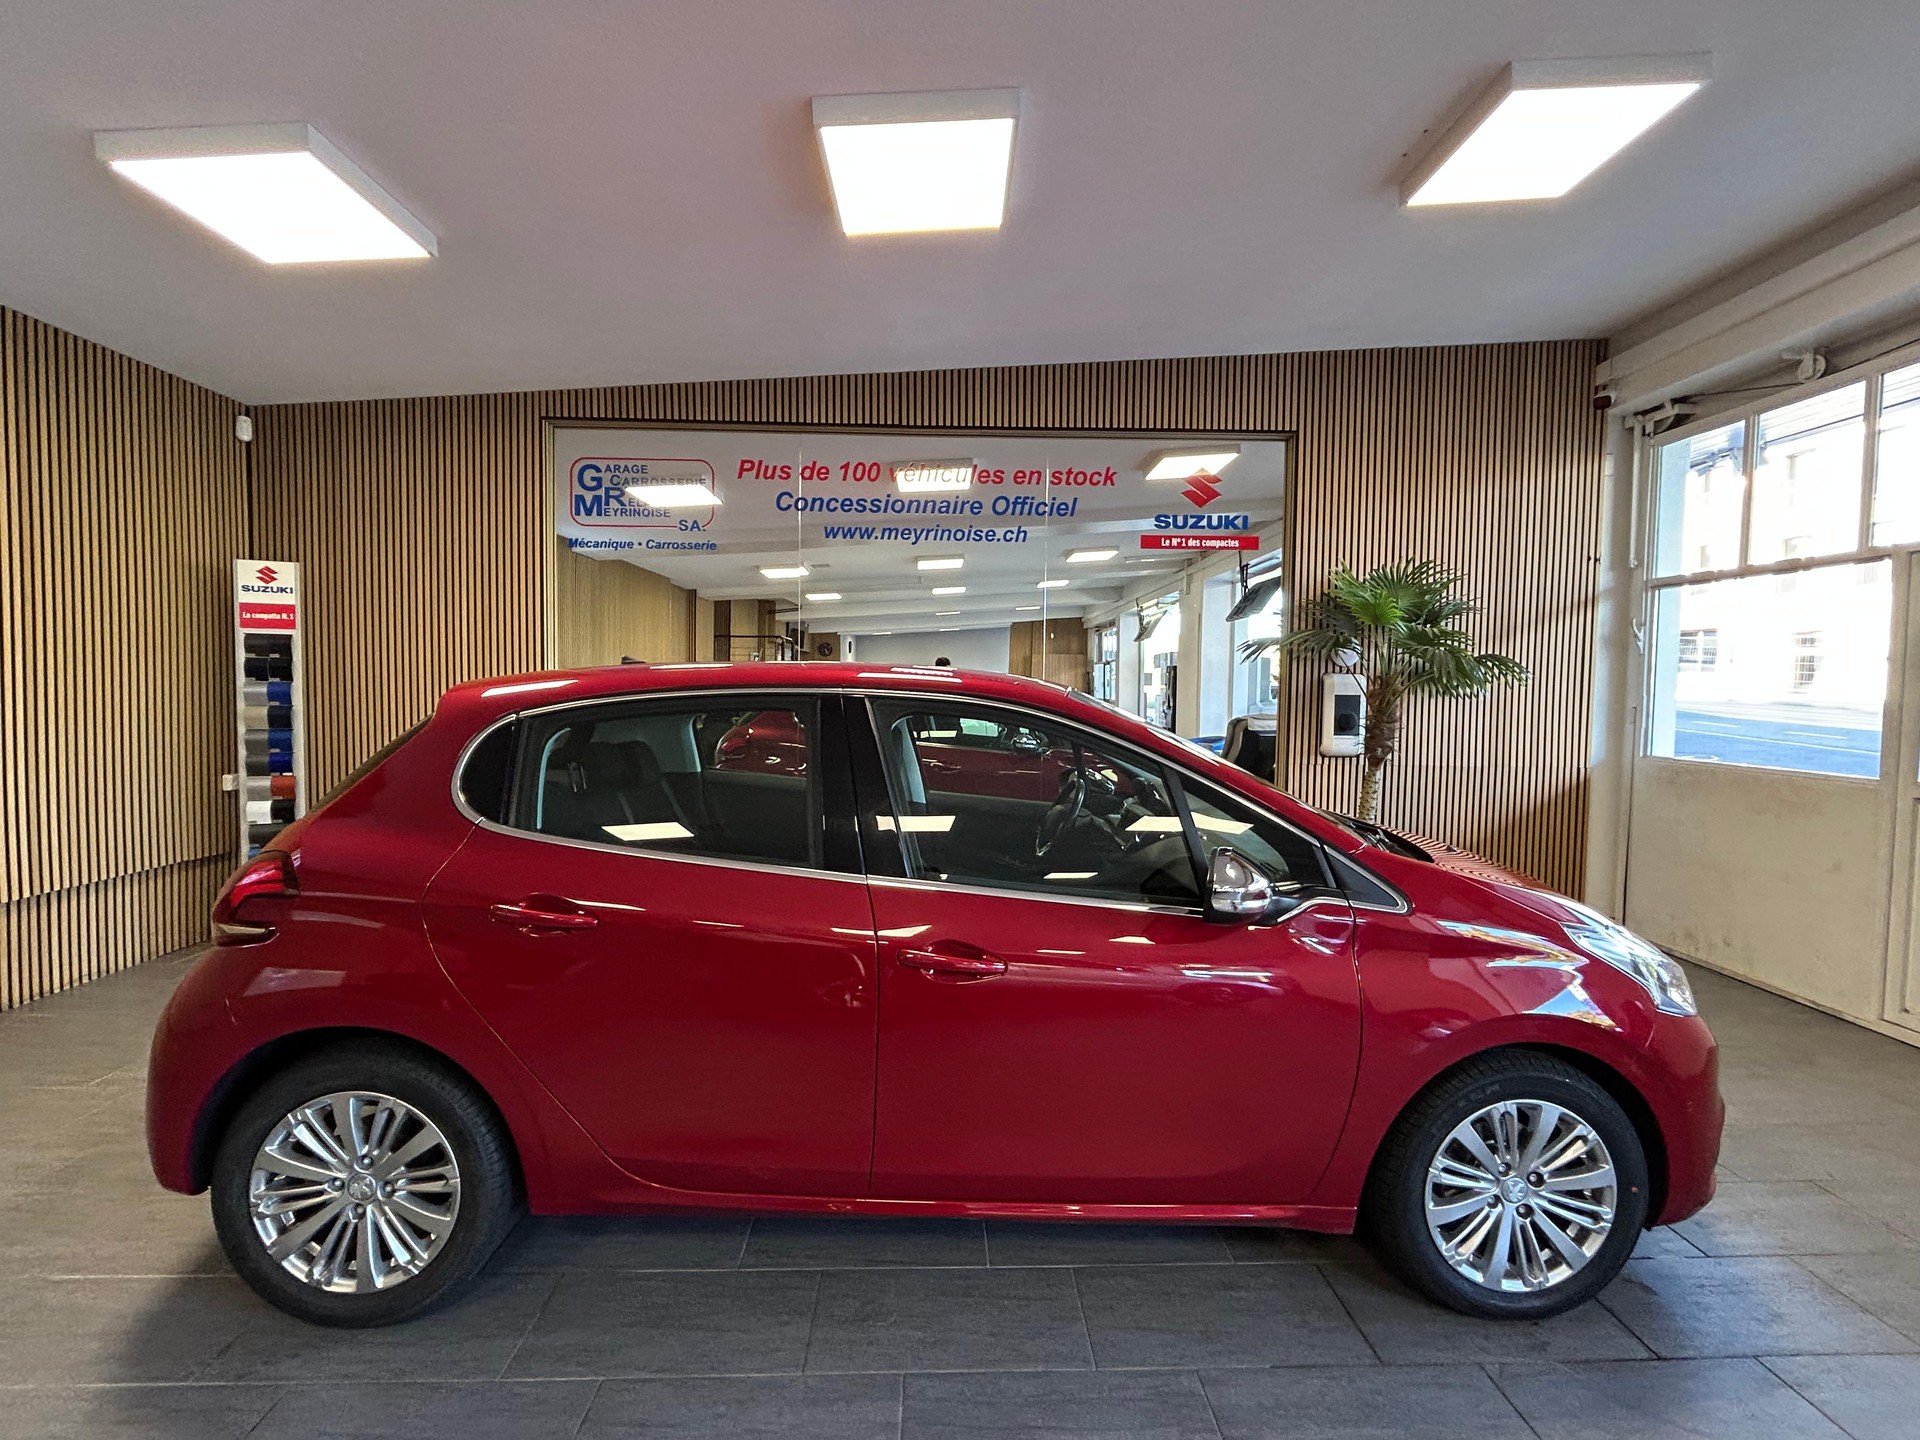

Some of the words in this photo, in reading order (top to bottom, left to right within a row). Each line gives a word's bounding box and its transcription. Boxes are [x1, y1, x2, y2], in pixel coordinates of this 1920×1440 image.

[737, 459, 792, 480] Plus
[800, 460, 830, 481] de
[839, 461, 881, 482] 100
[889, 461, 1005, 485] véhicules
[1013, 467, 1042, 486] en
[1049, 465, 1118, 487] stock
[775, 491, 983, 515] Concessionnaire
[991, 495, 1078, 517] Officiel
[1154, 514, 1249, 530] SUZUKI
[824, 525, 1028, 545] www.meyrinoise.ch
[1161, 537, 1170, 547] Le
[1187, 537, 1200, 547] des
[1201, 538, 1240, 549] compactes
[568, 537, 635, 551] Mécanique
[645, 539, 717, 551] Carrosserie
[241, 584, 294, 594] SUZUKI
